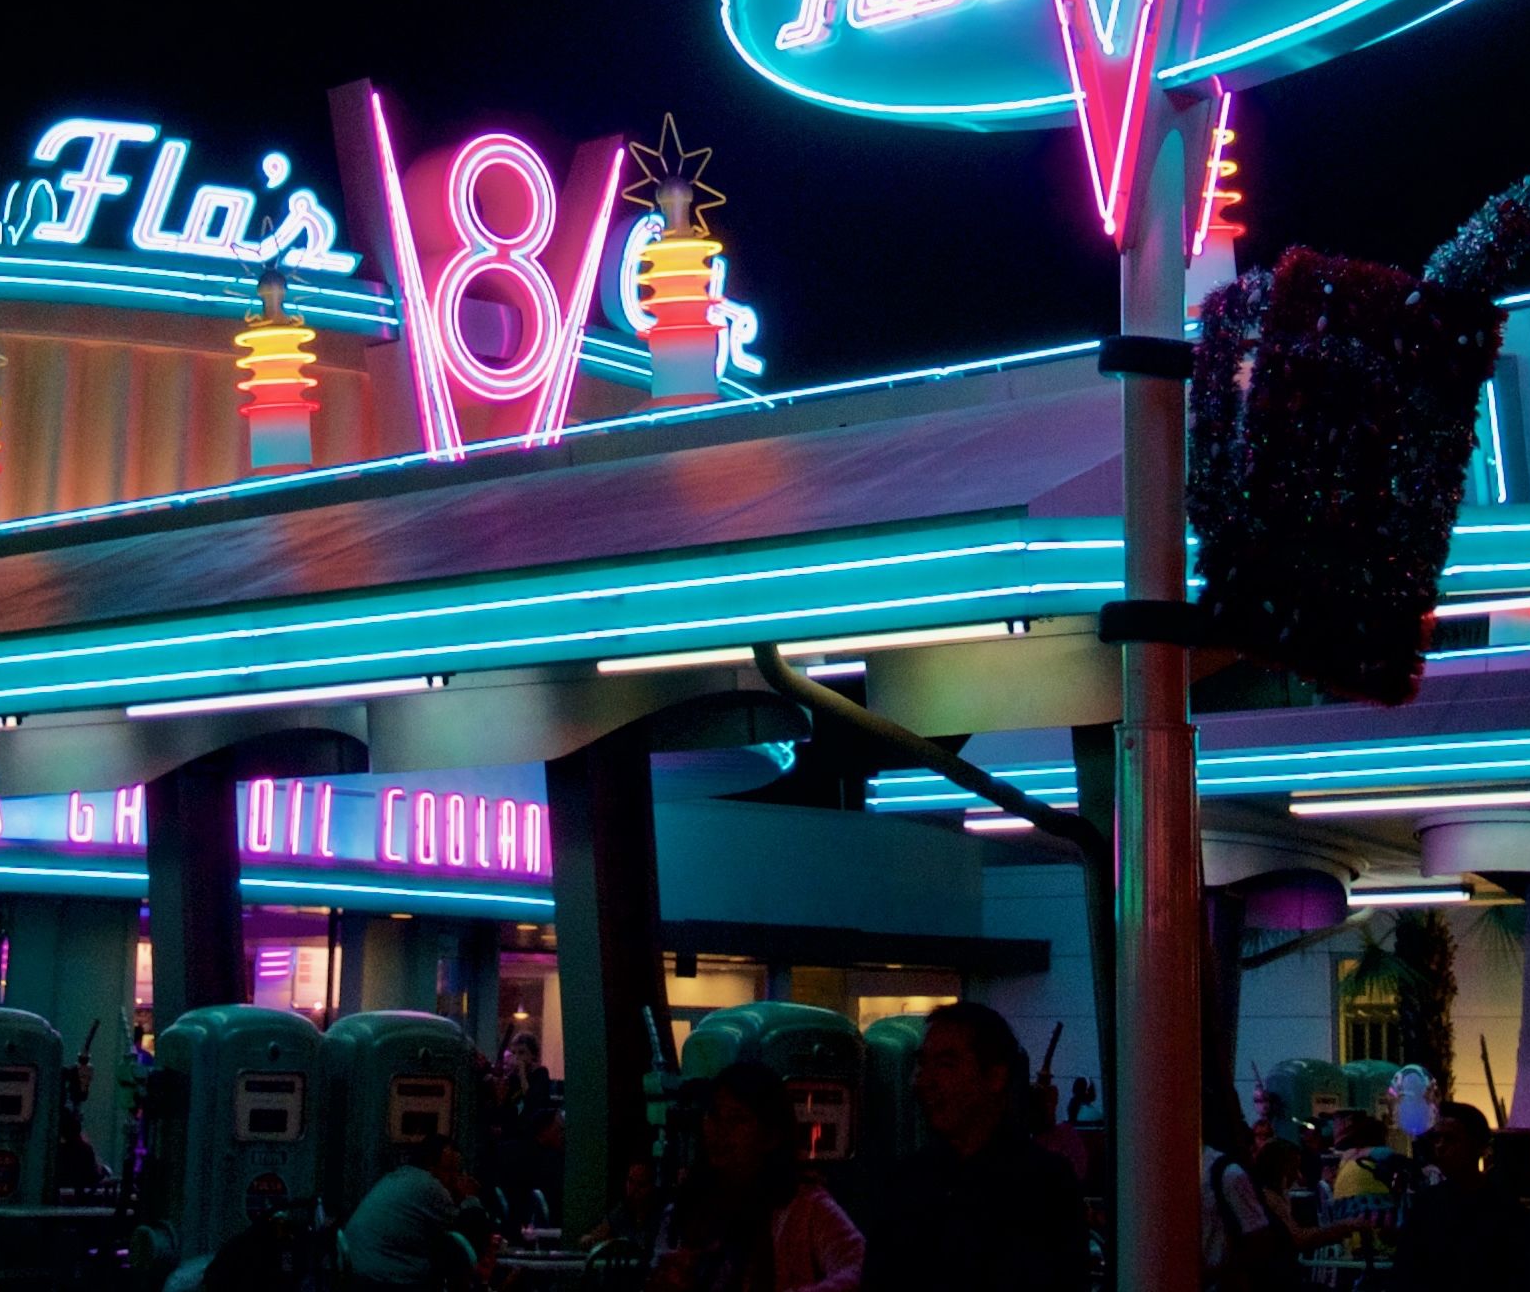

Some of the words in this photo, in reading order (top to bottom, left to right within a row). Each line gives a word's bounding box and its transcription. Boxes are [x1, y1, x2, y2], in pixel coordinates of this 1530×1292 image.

[34, 117, 359, 275] Flo's
[247, 778, 334, 858] OIL
[380, 787, 543, 875] COOLAN
